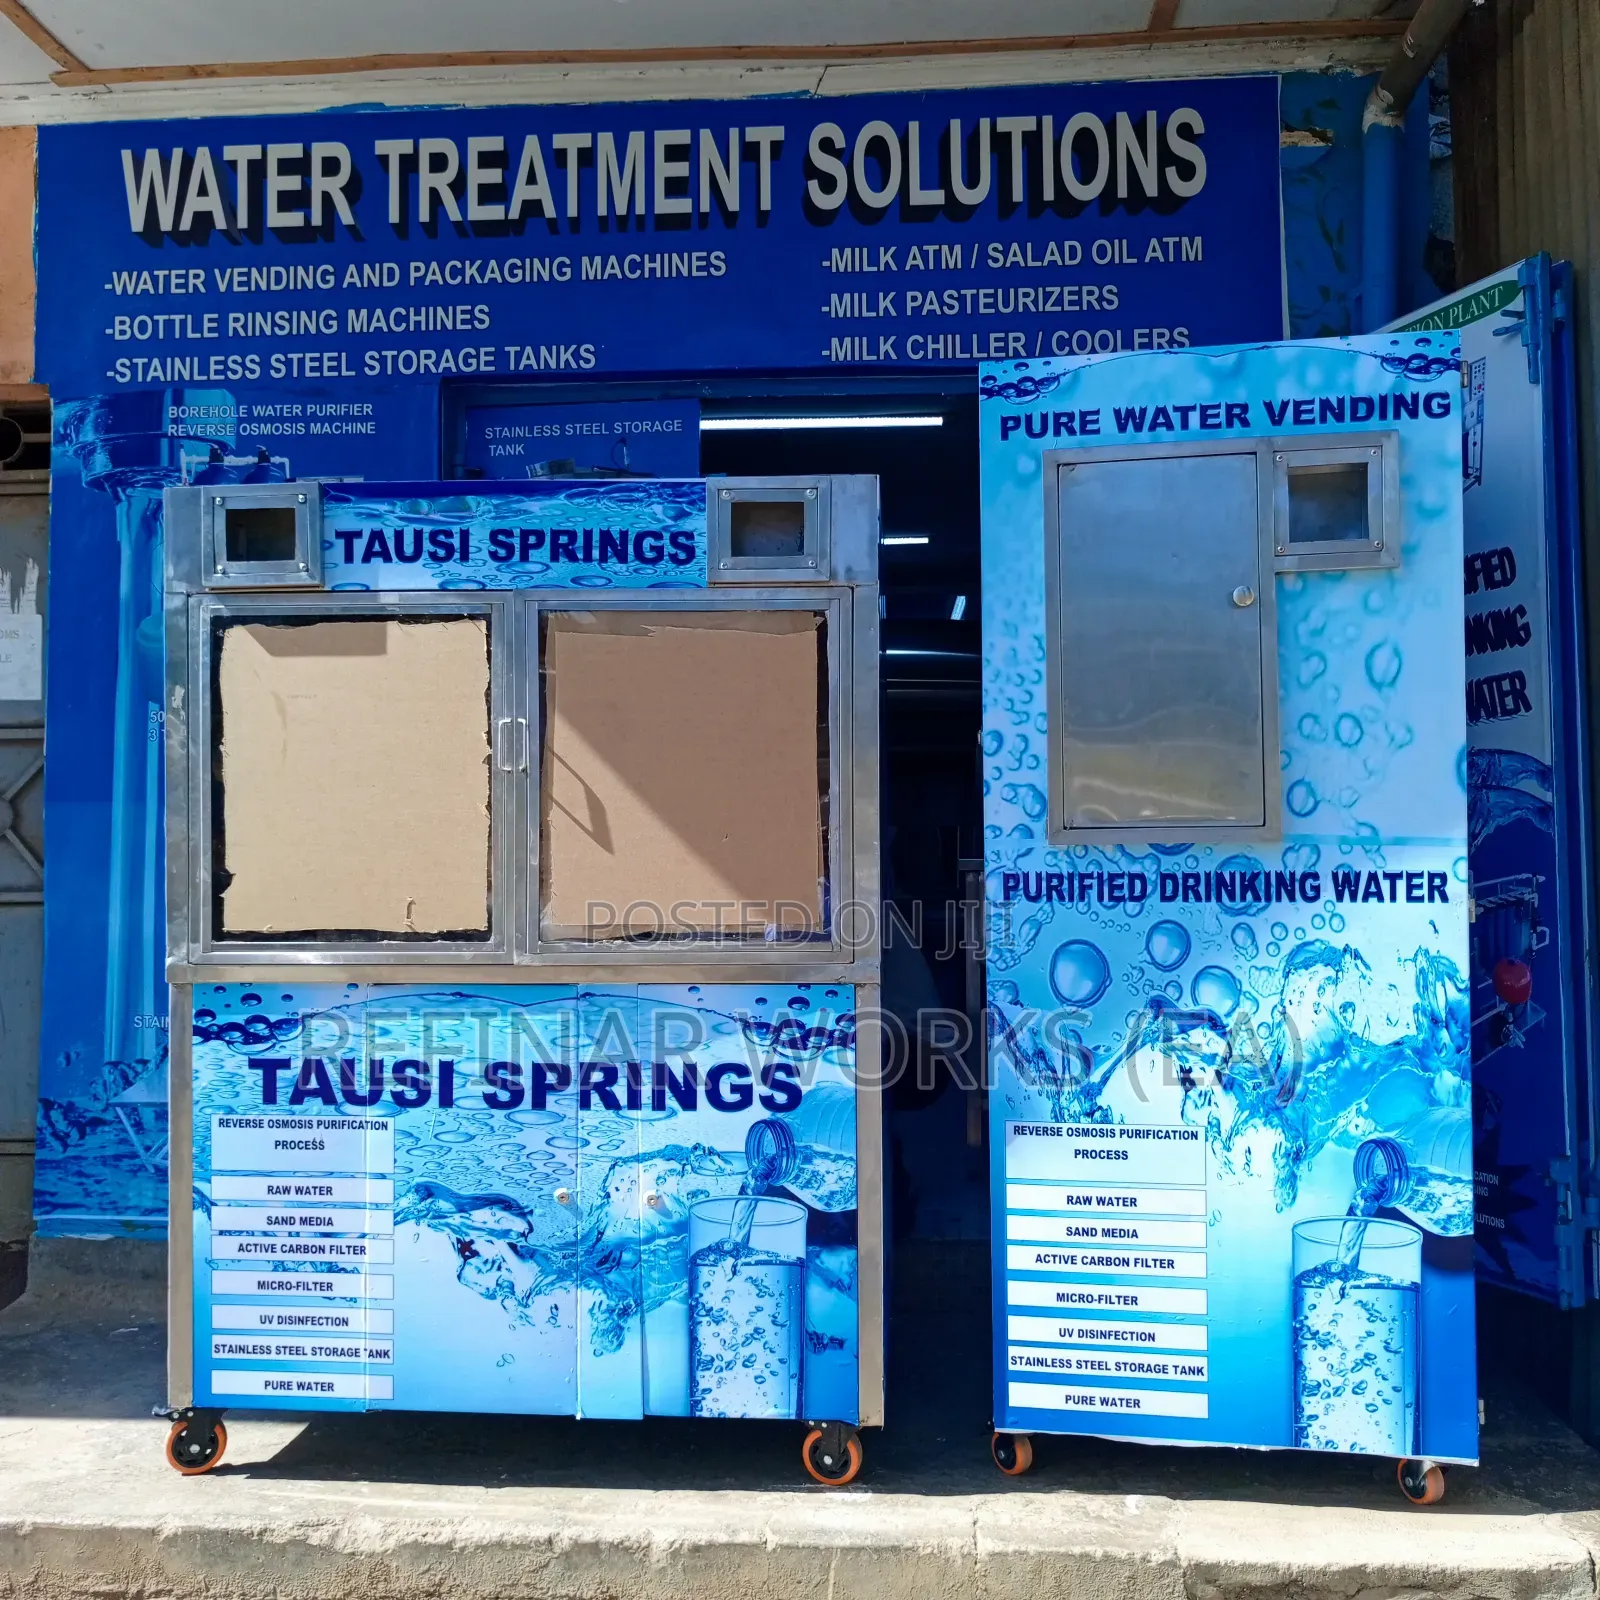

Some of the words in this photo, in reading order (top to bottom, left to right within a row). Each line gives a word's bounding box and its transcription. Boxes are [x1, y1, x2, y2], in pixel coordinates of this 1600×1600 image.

[121, 141, 355, 232] WATER
[374, 126, 785, 224] TREATMENT
[806, 107, 1207, 211] SOLUTIONS
[822, 246, 898, 273] -MILK
[905, 244, 962, 271] ATM
[970, 243, 979, 268] /
[987, 240, 1083, 268] SALAD
[1091, 238, 1138, 264] OIL
[1144, 236, 1203, 264] ATM
[104, 269, 206, 295] -WATER
[214, 264, 335, 293] VENDING
[342, 262, 400, 288] AND
[409, 256, 572, 286] PACKAGING
[581, 251, 727, 281] MACHINES
[821, 292, 897, 318] -MILK
[906, 285, 1119, 316] PASTEURIZERS
[1449, 285, 1504, 327] PLANT
[105, 313, 219, 340] -BOTTLE
[228, 309, 338, 337] RINSING
[347, 304, 490, 333] MACHINES
[821, 336, 897, 362] -MILK
[906, 332, 1027, 360] CHILLER
[1035, 331, 1043, 356] /
[1051, 327, 1190, 356] COOLERS
[106, 354, 261, 383] -STAINLESS
[270, 352, 355, 379] STEEL
[364, 347, 495, 375] STORAGE
[504, 344, 596, 370] TANKS
[168, 405, 248, 419] BOREHOLE
[252, 404, 302, 417] WATER
[307, 403, 373, 416] PURIFIER
[1000, 407, 1100, 442] PURE
[1112, 401, 1251, 433] WATER
[1262, 391, 1451, 428] VENDING
[168, 424, 236, 437] REVERSE
[239, 423, 306, 435] OSMOSIS
[310, 422, 376, 434] MACHINE
[485, 424, 560, 439] STAINLESS
[565, 423, 609, 436] STEEL
[613, 420, 683, 434] STORAGE
[489, 443, 525, 456] TANK
[334, 527, 471, 564] TAUSI
[487, 526, 697, 567] SPRINGS
[1002, 870, 1148, 903] PURIFIED
[1159, 870, 1321, 903] DRINKING
[1331, 869, 1449, 903] WATER
[248, 1057, 456, 1109] TAUSI
[481, 1059, 804, 1113] SPRINGS
[218, 1118, 265, 1130] REVERSE
[267, 1119, 314, 1131] OSMOSIS
[316, 1119, 389, 1132] PURIFICATION
[1013, 1125, 1064, 1137] REVERSE
[1066, 1126, 1116, 1139] OSMOSIS
[1119, 1128, 1199, 1141] PURIFICATION
[274, 1139, 325, 1151] PROCESS
[1074, 1149, 1129, 1161] PROCESS
[267, 1185, 292, 1196] RAW
[294, 1186, 333, 1196] WATER
[1066, 1195, 1093, 1206] RAW
[1095, 1196, 1138, 1208] WATER
[266, 1215, 297, 1226] SAND
[299, 1216, 334, 1227] MEDIA
[1065, 1226, 1098, 1238] SAND
[1101, 1227, 1139, 1239] MEDIA
[237, 1243, 278, 1254] ACTIVE
[280, 1244, 326, 1255] CARBON
[328, 1245, 367, 1256] FILTER
[1035, 1253, 1078, 1265] ACTIVE
[1081, 1255, 1130, 1267] CARBON
[1133, 1257, 1175, 1269] FILTER
[257, 1280, 334, 1292] MICRO-FILTER
[1056, 1292, 1139, 1306] MICRO-FILTER
[259, 1315, 275, 1325] UV
[277, 1315, 349, 1327] DISINFECTION
[1058, 1327, 1074, 1338] UV
[1077, 1328, 1156, 1342] DISINFECTION
[214, 1344, 272, 1355] STAINLESS
[275, 1345, 308, 1356] STEEL
[310, 1346, 361, 1358] STORAGE
[1010, 1356, 1073, 1369] STAINLESS
[1075, 1360, 1112, 1371] STEEL
[1114, 1361, 1169, 1375] STORAGE
[1172, 1365, 1205, 1377] TANK
[264, 1380, 294, 1391] PURE
[296, 1381, 335, 1391] WATER
[1065, 1395, 1096, 1406] PURE
[1099, 1396, 1141, 1409] WATER
